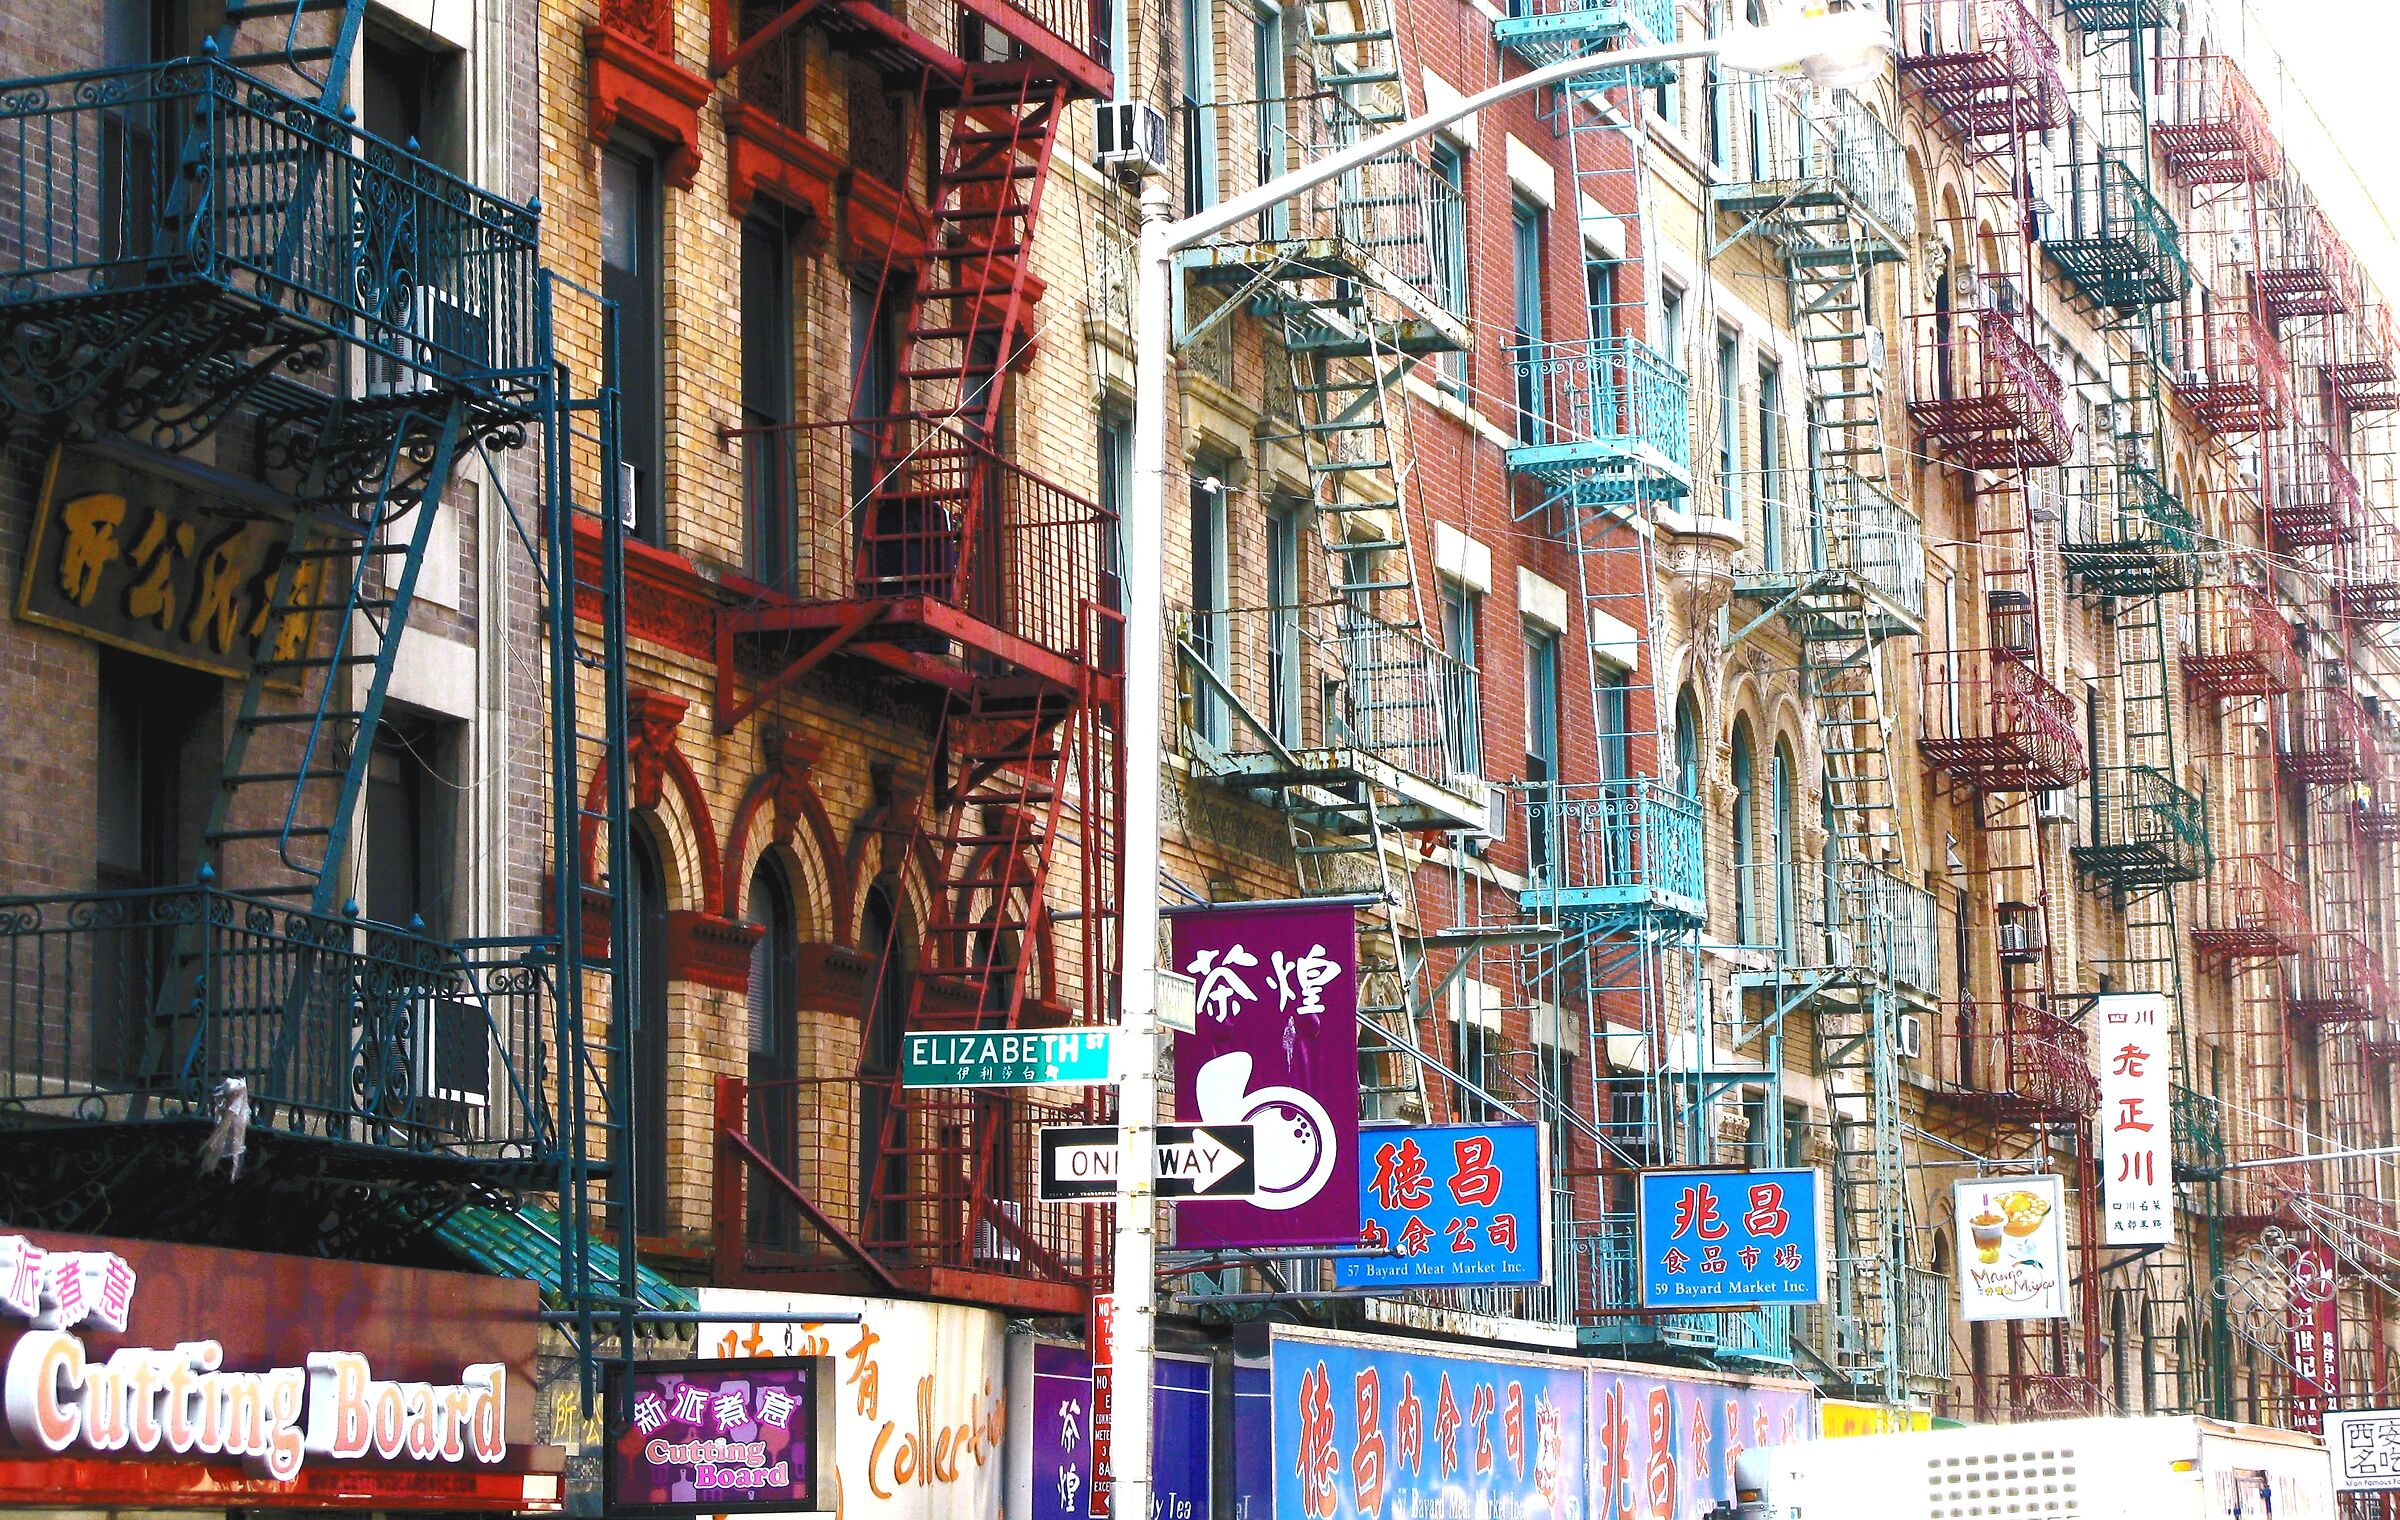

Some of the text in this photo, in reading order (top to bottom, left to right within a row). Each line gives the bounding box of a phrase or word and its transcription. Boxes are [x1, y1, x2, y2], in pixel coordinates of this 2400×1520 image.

[1157, 976, 1184, 1009] AYARD
[1187, 944, 1342, 1023] 茶煌
[2107, 1009, 2154, 1025] 四川
[912, 1034, 1105, 1065] ELIZABETH ST
[2113, 1043, 2155, 1186] 老正川
[1071, 1148, 1221, 1177] ON WAY
[1368, 1136, 1502, 1210] 德昌
[1671, 1182, 1790, 1240] 兆昌
[1356, 1214, 1517, 1257] 肉食公司
[1347, 1259, 1526, 1279] 57 Bayard Meat Market Inc.
[1661, 1244, 1802, 1274] 食品市場
[1654, 1279, 1809, 1297] 59 Bayard Market Inc.
[1098, 1302, 1110, 1317] NO
[1096, 1375, 1108, 1390] NO
[24, 1333, 506, 1481] Cutting Board
[633, 1386, 795, 1436] 新派煮意
[1095, 1429, 1111, 1441] METE
[1296, 1359, 1524, 1519] 德昌肉食公司
[2347, 1420, 2400, 1448] 西安
[645, 1437, 767, 1467] Cutting
[1057, 1398, 1081, 1512] 茶煌
[694, 1460, 789, 1488] Board
[1098, 1462, 1111, 1476] 8A
[1093, 1481, 1111, 1493] EXCE
[1150, 1491, 1192, 1520] ly Tea
